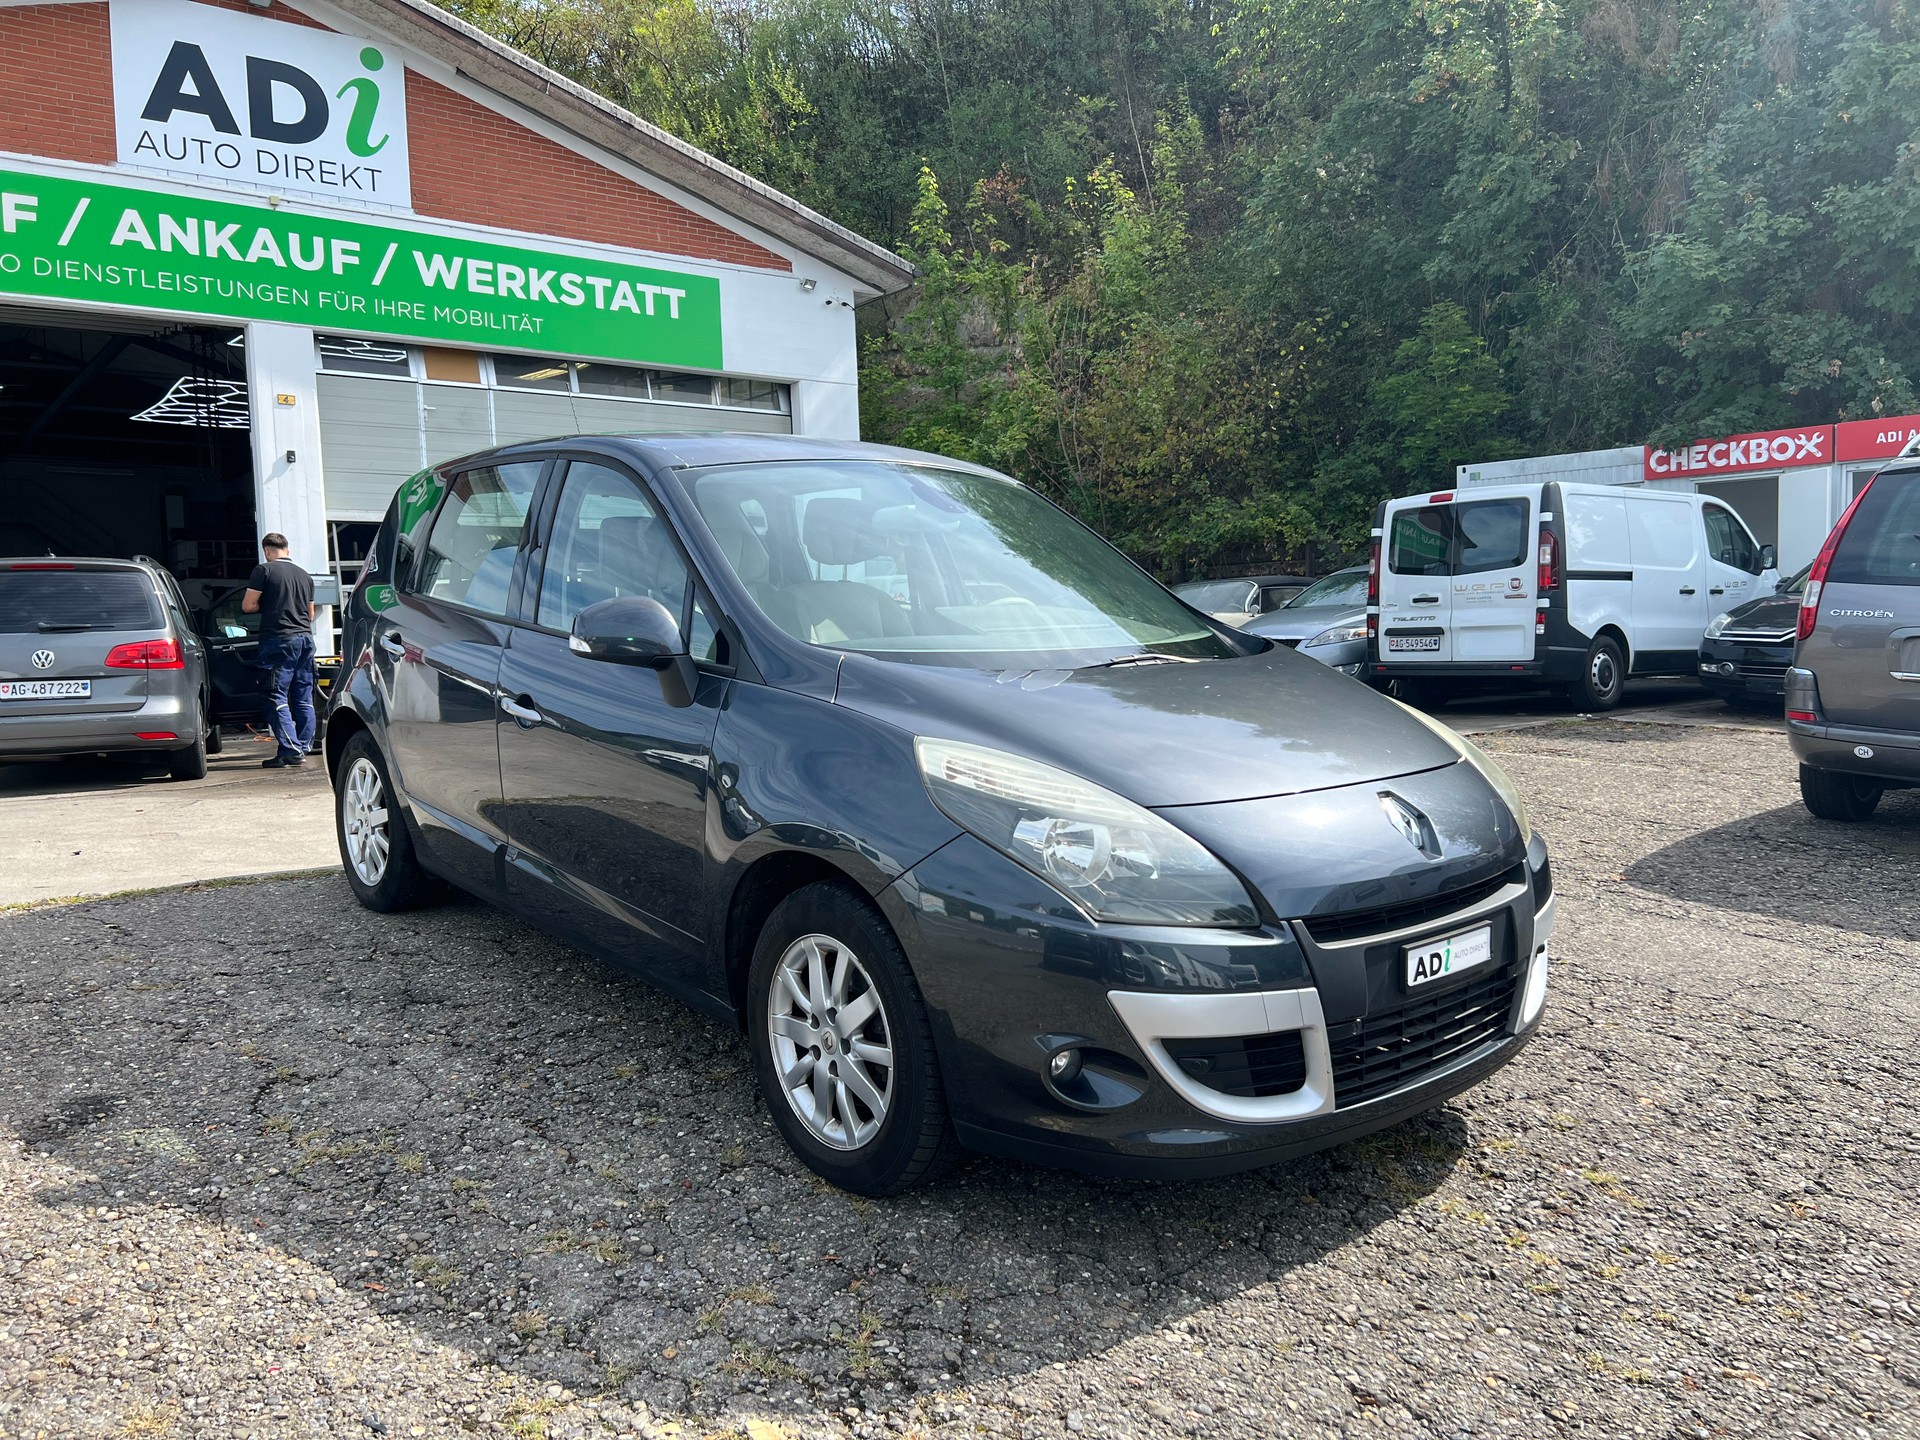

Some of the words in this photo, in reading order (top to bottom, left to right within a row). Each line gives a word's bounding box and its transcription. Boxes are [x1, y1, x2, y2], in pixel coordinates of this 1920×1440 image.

[134, 130, 241, 169] AUTO
[257, 150, 382, 192] DIREKT
[110, 208, 361, 276] ANKAUF
[413, 250, 686, 319] WERKSTATT
[34, 257, 309, 307] DIENSTLEISTUNGEN
[319, 290, 366, 315] FÜR
[374, 298, 425, 320] IHRE
[434, 306, 544, 334] MOBILITÄT
[1876, 430, 1902, 444] ADI
[1829, 609, 1894, 618] CITROËN
[1858, 748, 1869, 756] CH
[1454, 948, 1469, 959] AUTO
[1469, 941, 1487, 954] DIREKT
